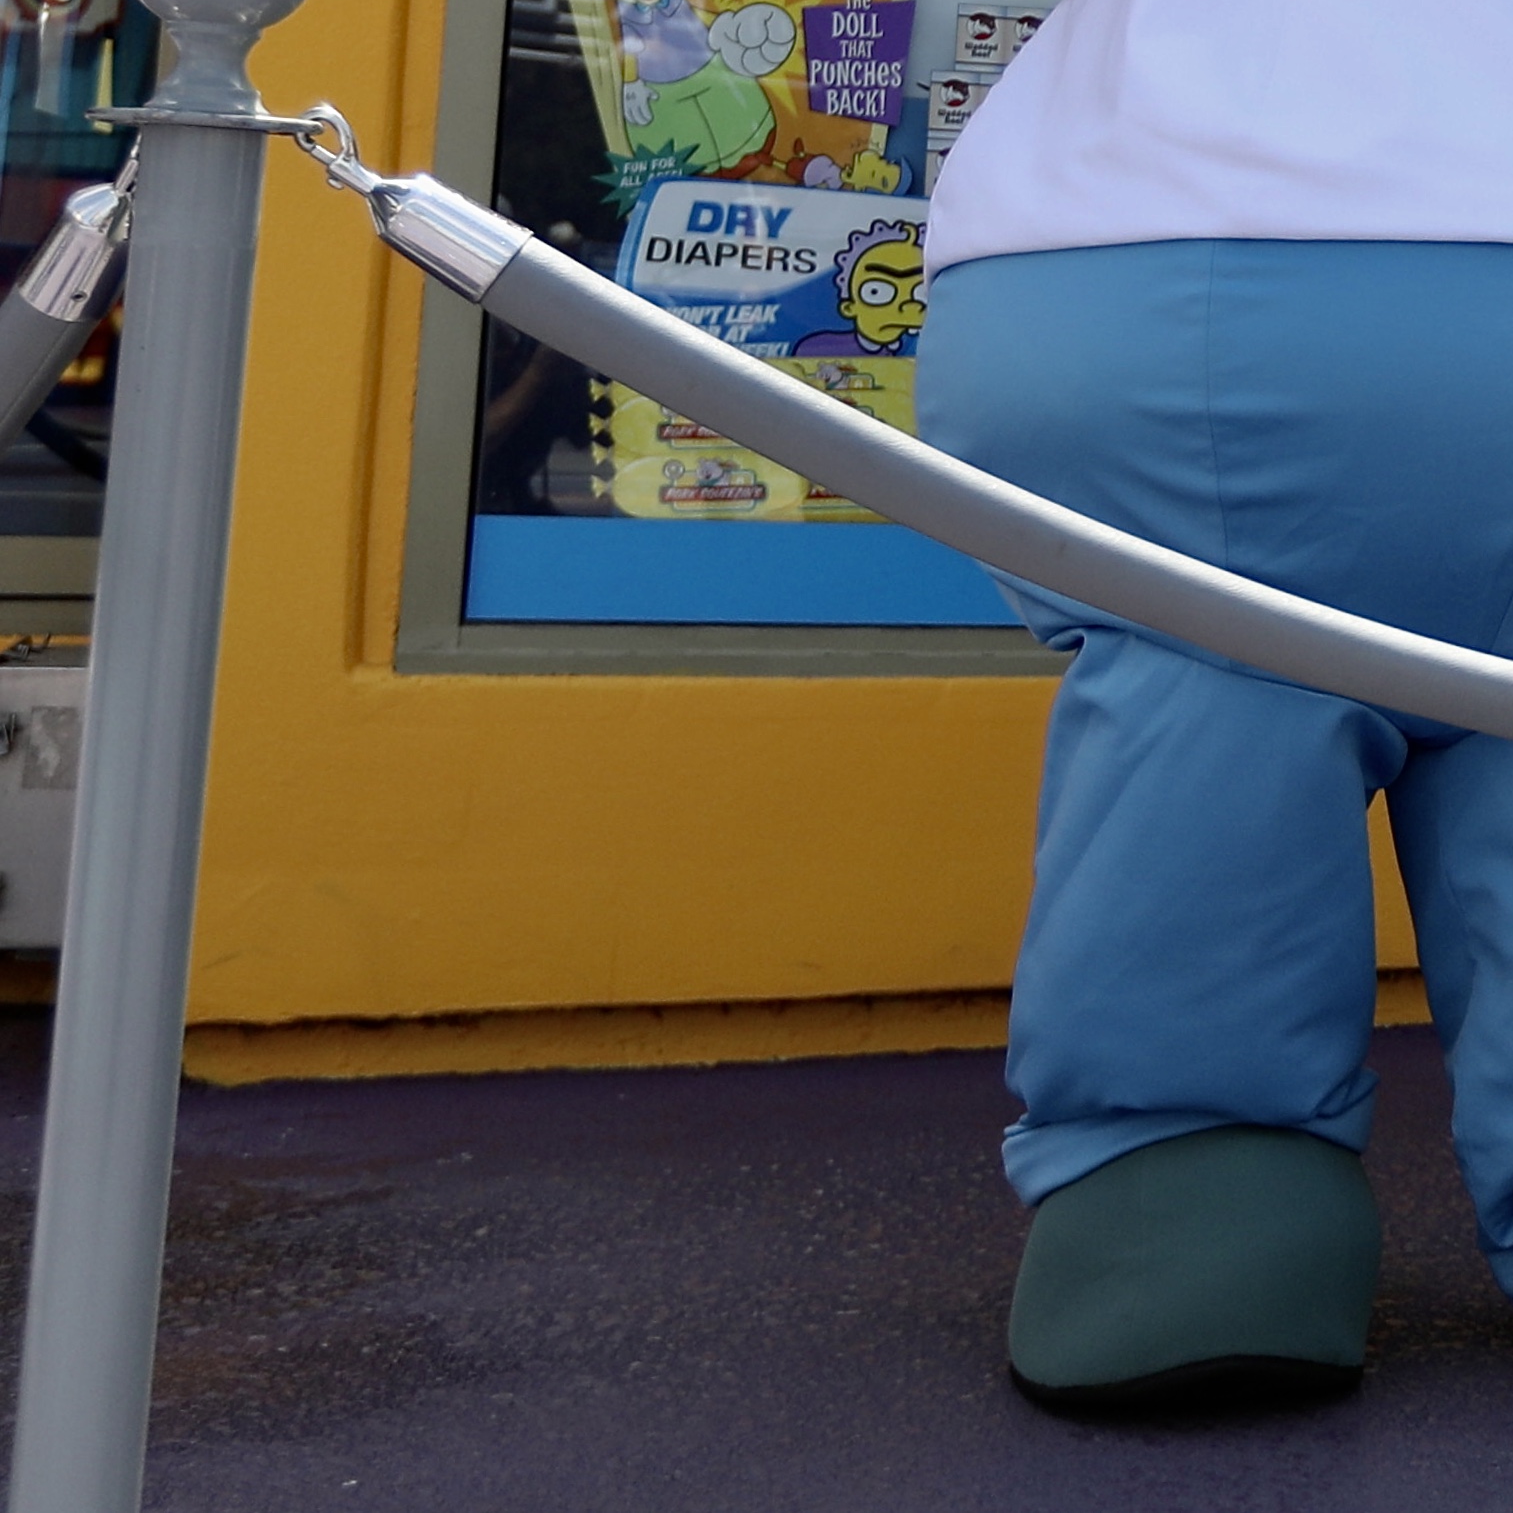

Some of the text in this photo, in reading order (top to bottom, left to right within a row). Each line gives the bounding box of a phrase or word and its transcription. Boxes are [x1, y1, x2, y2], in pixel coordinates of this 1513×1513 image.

[832, 11, 883, 38] DOLL
[840, 40, 874, 59] THAT
[826, 89, 886, 117] BACK!
[623, 156, 677, 174] FUN FOR
[620, 175, 643, 188] ALL
[687, 200, 793, 240] DRY
[645, 236, 818, 274] DIAPERS
[724, 303, 781, 324] LEAK
